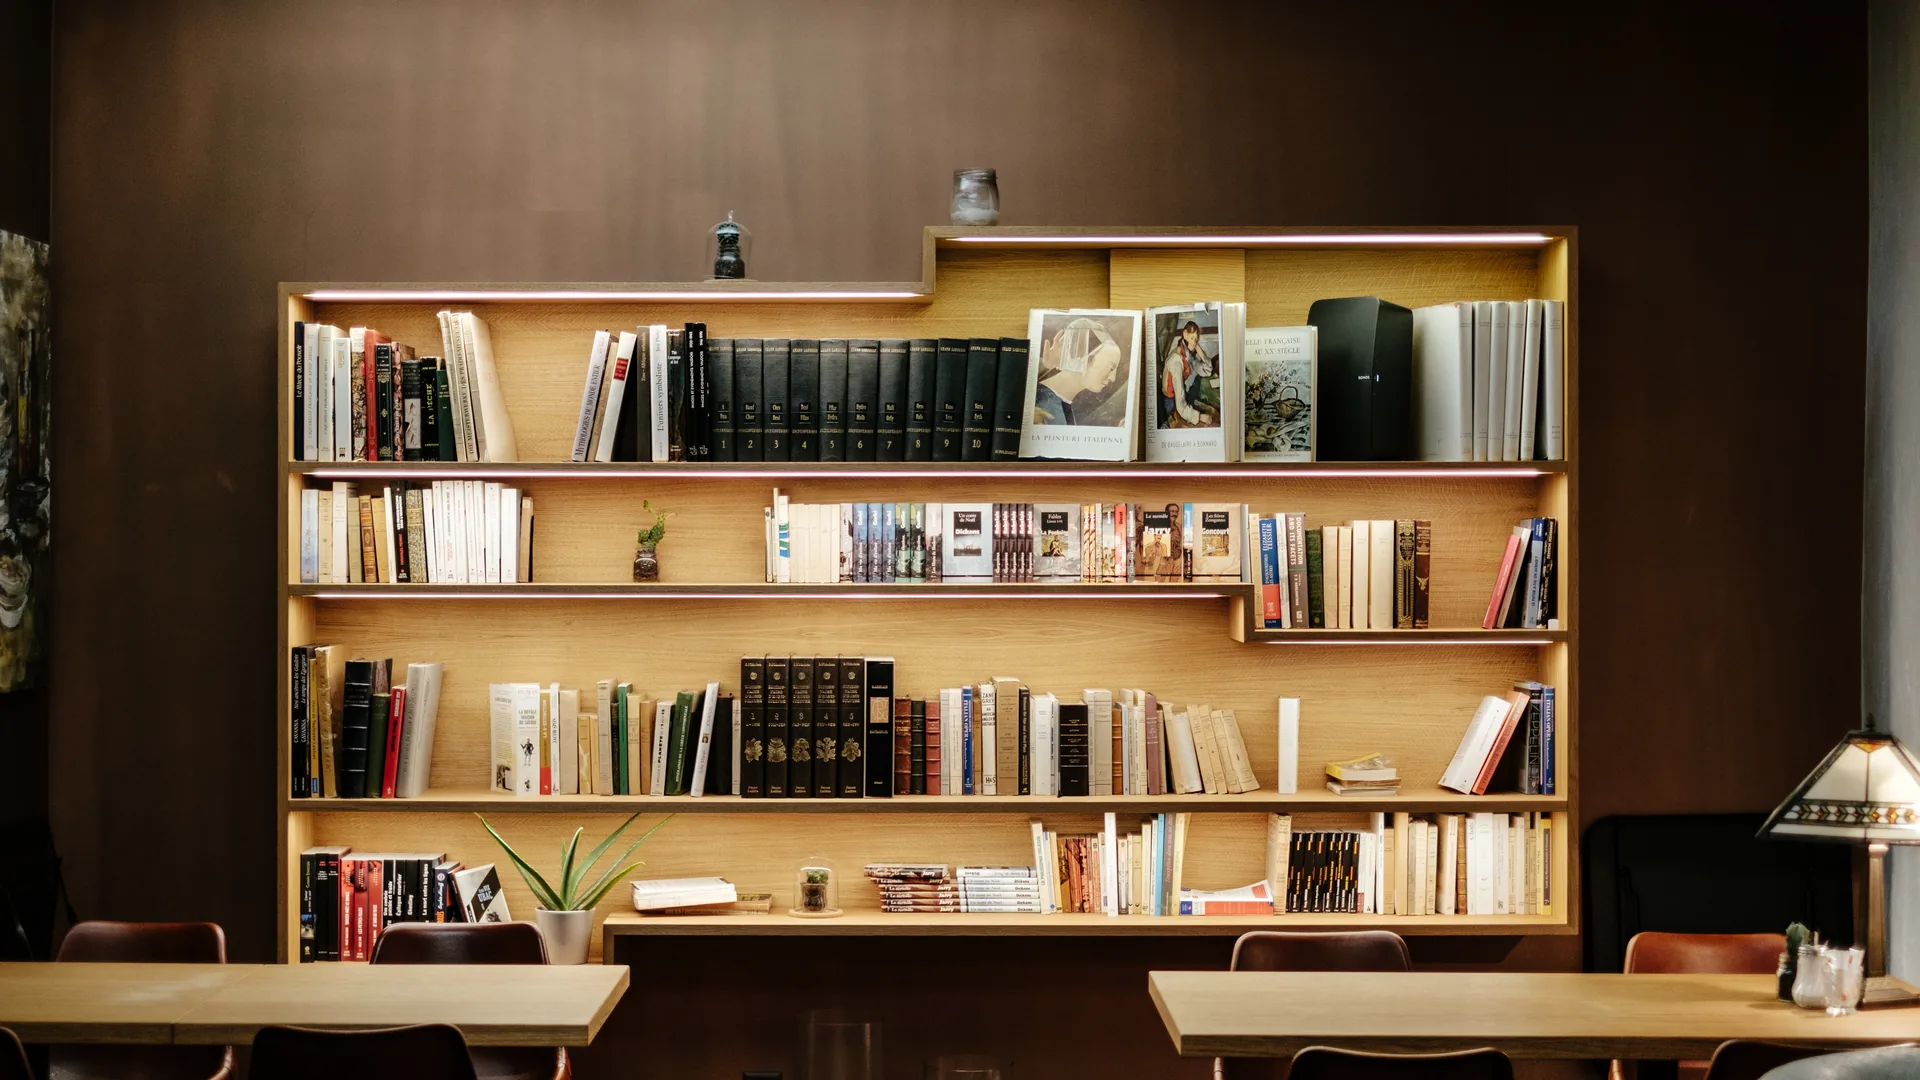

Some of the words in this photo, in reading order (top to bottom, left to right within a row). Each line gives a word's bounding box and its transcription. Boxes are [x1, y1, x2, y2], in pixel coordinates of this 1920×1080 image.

[1264, 337, 1301, 345] FRANÇAISE
[656, 363, 664, 398] symboliste
[586, 386, 597, 406] MONDE
[585, 407, 591, 416] DU
[428, 414, 435, 425] LA
[721, 440, 726, 449] 1
[748, 440, 753, 449] 2
[774, 440, 779, 449] 3
[830, 440, 835, 449] 5
[858, 440, 863, 449] 6
[915, 440, 921, 448] 8
[944, 439, 950, 448] 9
[972, 440, 981, 448] 10
[1084, 436, 1124, 444] ITALIENNE
[802, 441, 807, 449] 4
[887, 441, 892, 449] 7
[1144, 526, 1171, 535] Jarry
[750, 712, 756, 720] 1
